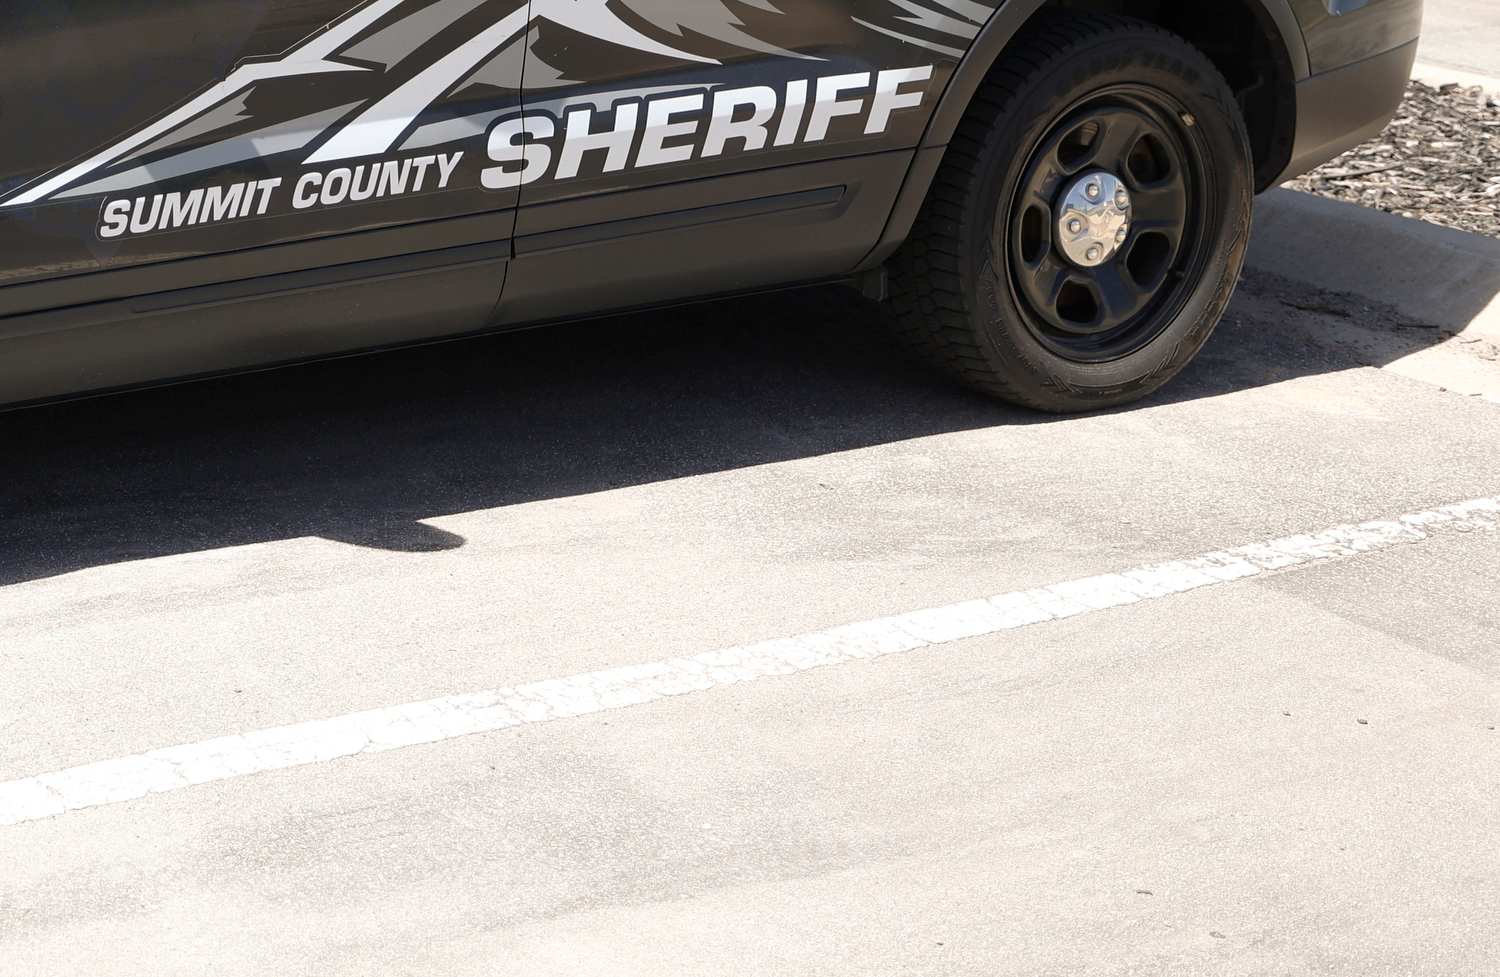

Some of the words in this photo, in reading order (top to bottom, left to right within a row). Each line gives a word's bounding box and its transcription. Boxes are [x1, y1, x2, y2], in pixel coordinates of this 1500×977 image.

[99, 177, 283, 238] SUMMIT
[292, 150, 465, 209] COUNTY
[480, 64, 934, 189] SHERIFF
